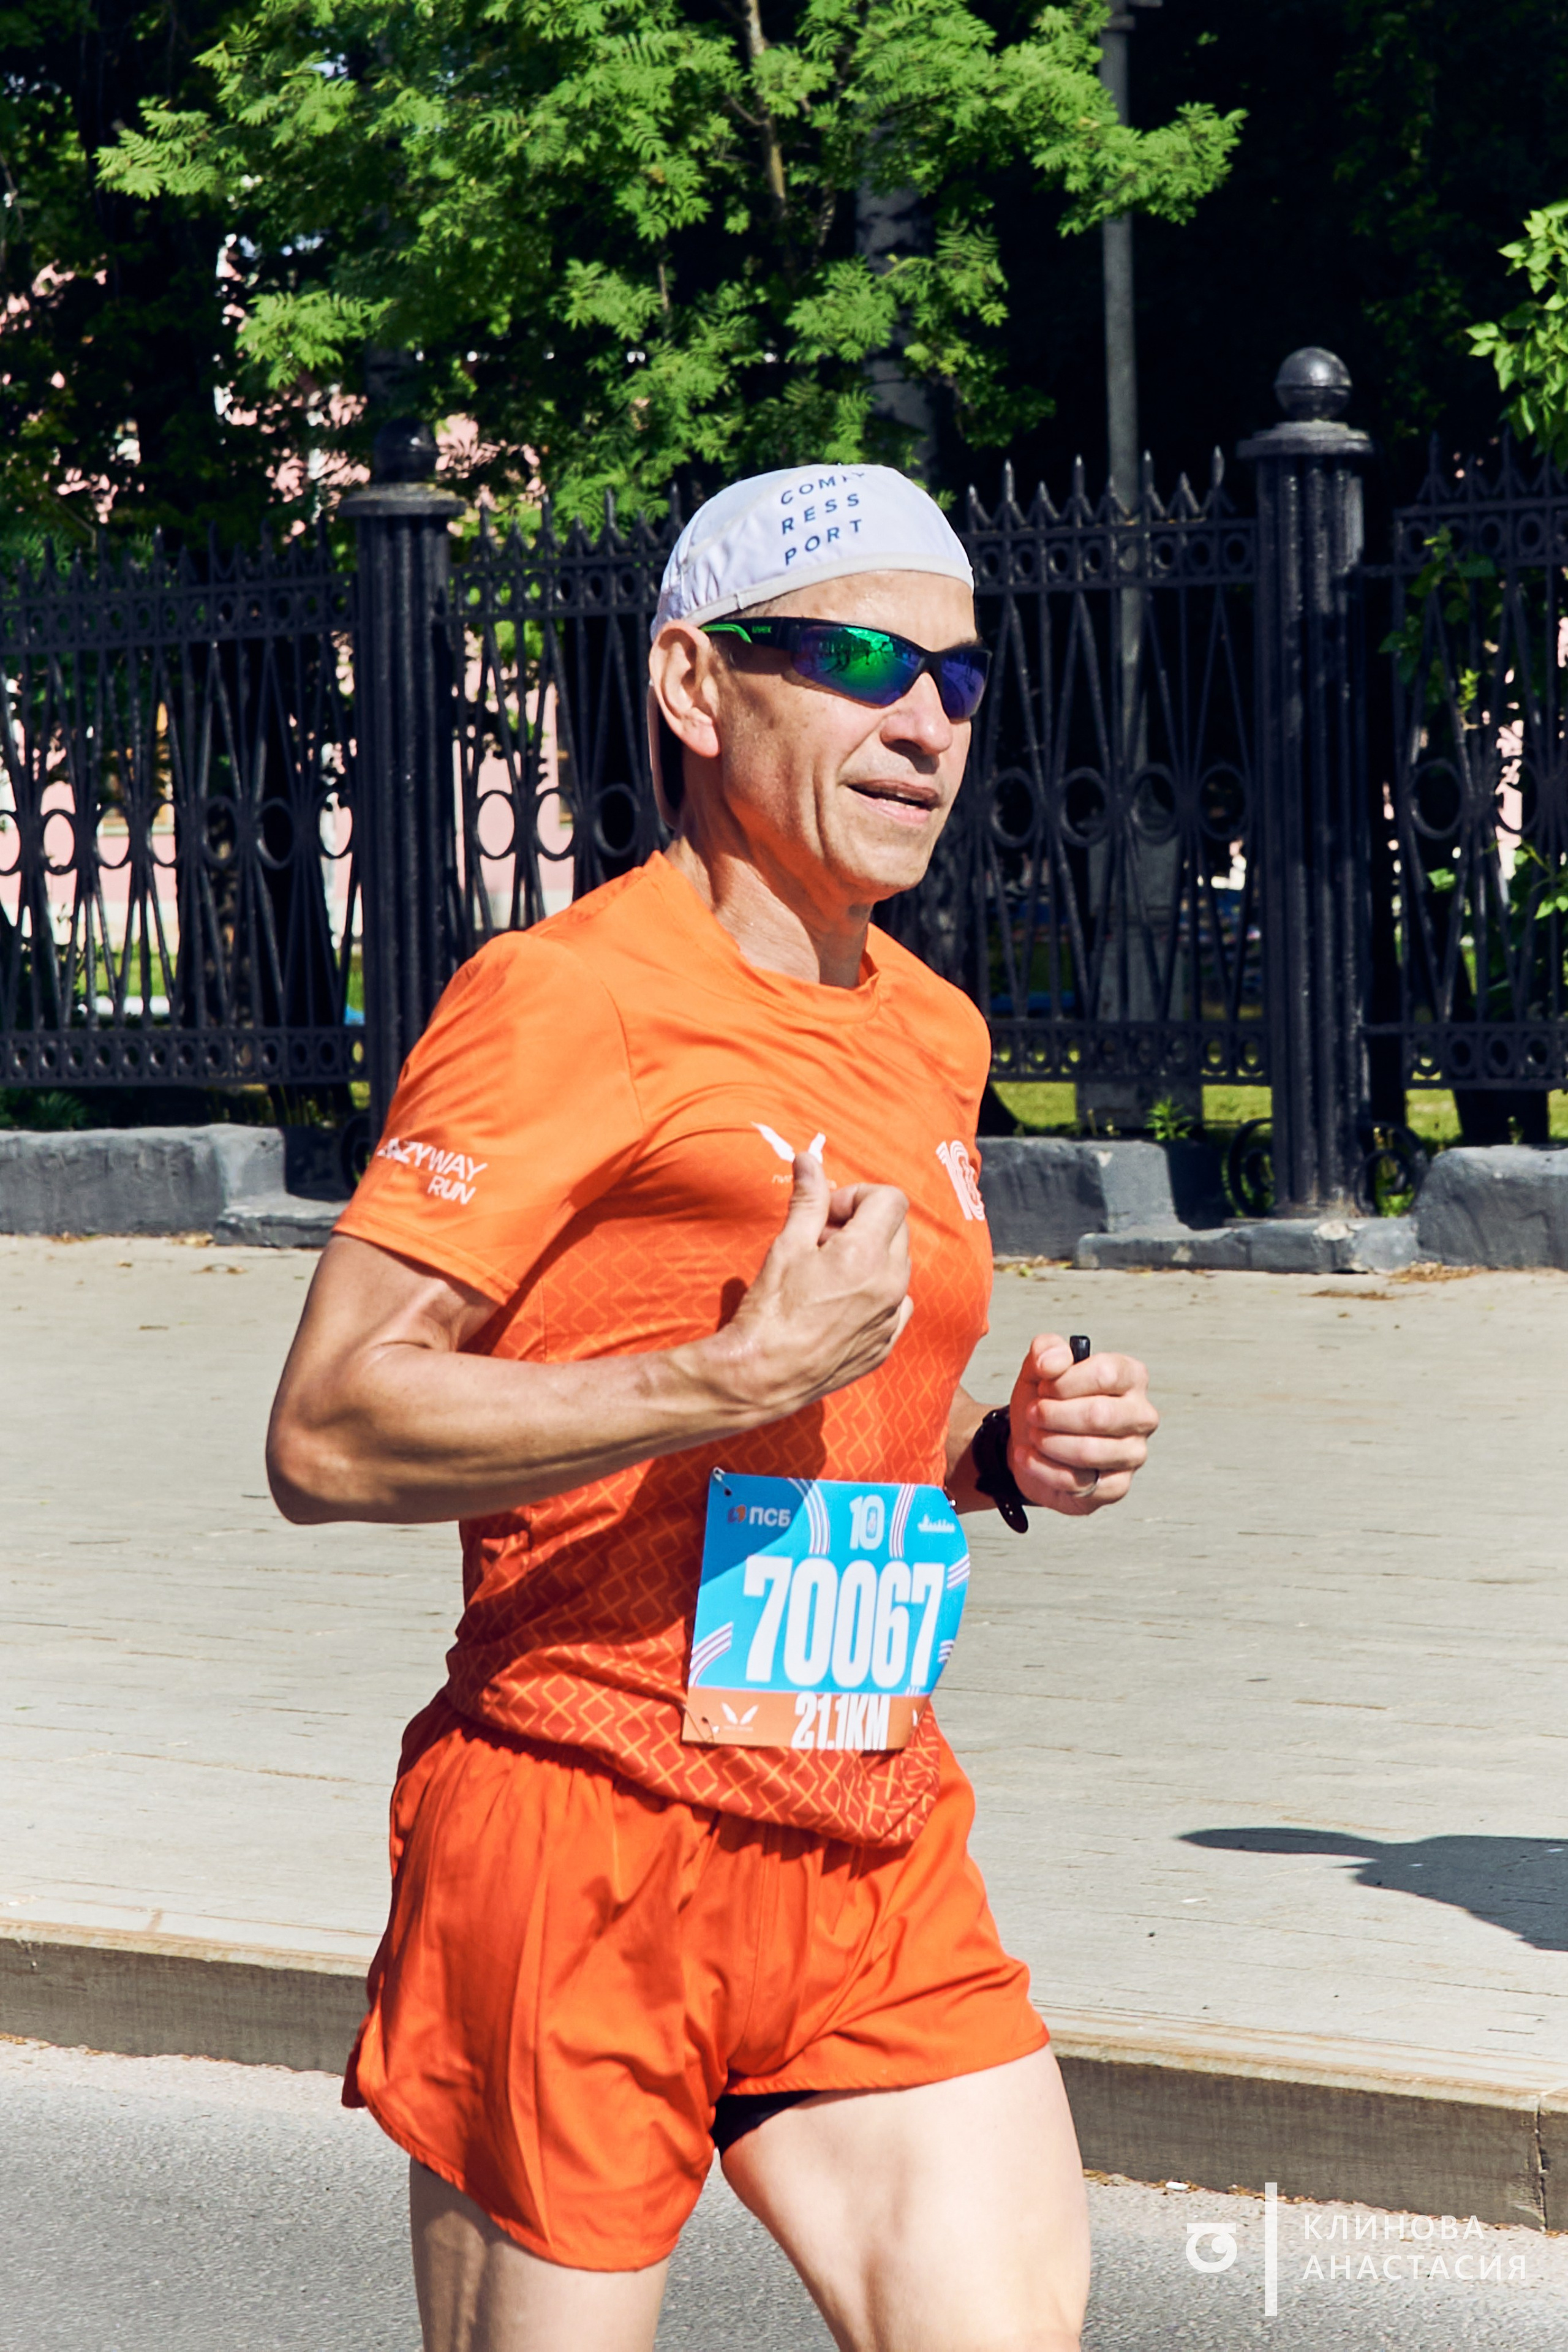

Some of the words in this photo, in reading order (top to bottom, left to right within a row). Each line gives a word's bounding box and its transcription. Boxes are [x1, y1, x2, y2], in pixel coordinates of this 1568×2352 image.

[782, 493, 859, 535] RESS
[785, 519, 862, 566] PORT
[428, 1175, 477, 1205] RUN
[749, 1506, 791, 1527] ПСБ
[849, 1494, 885, 1550] 10
[743, 1556, 946, 1688] 70067
[791, 1692, 891, 1751] 21.1KM
